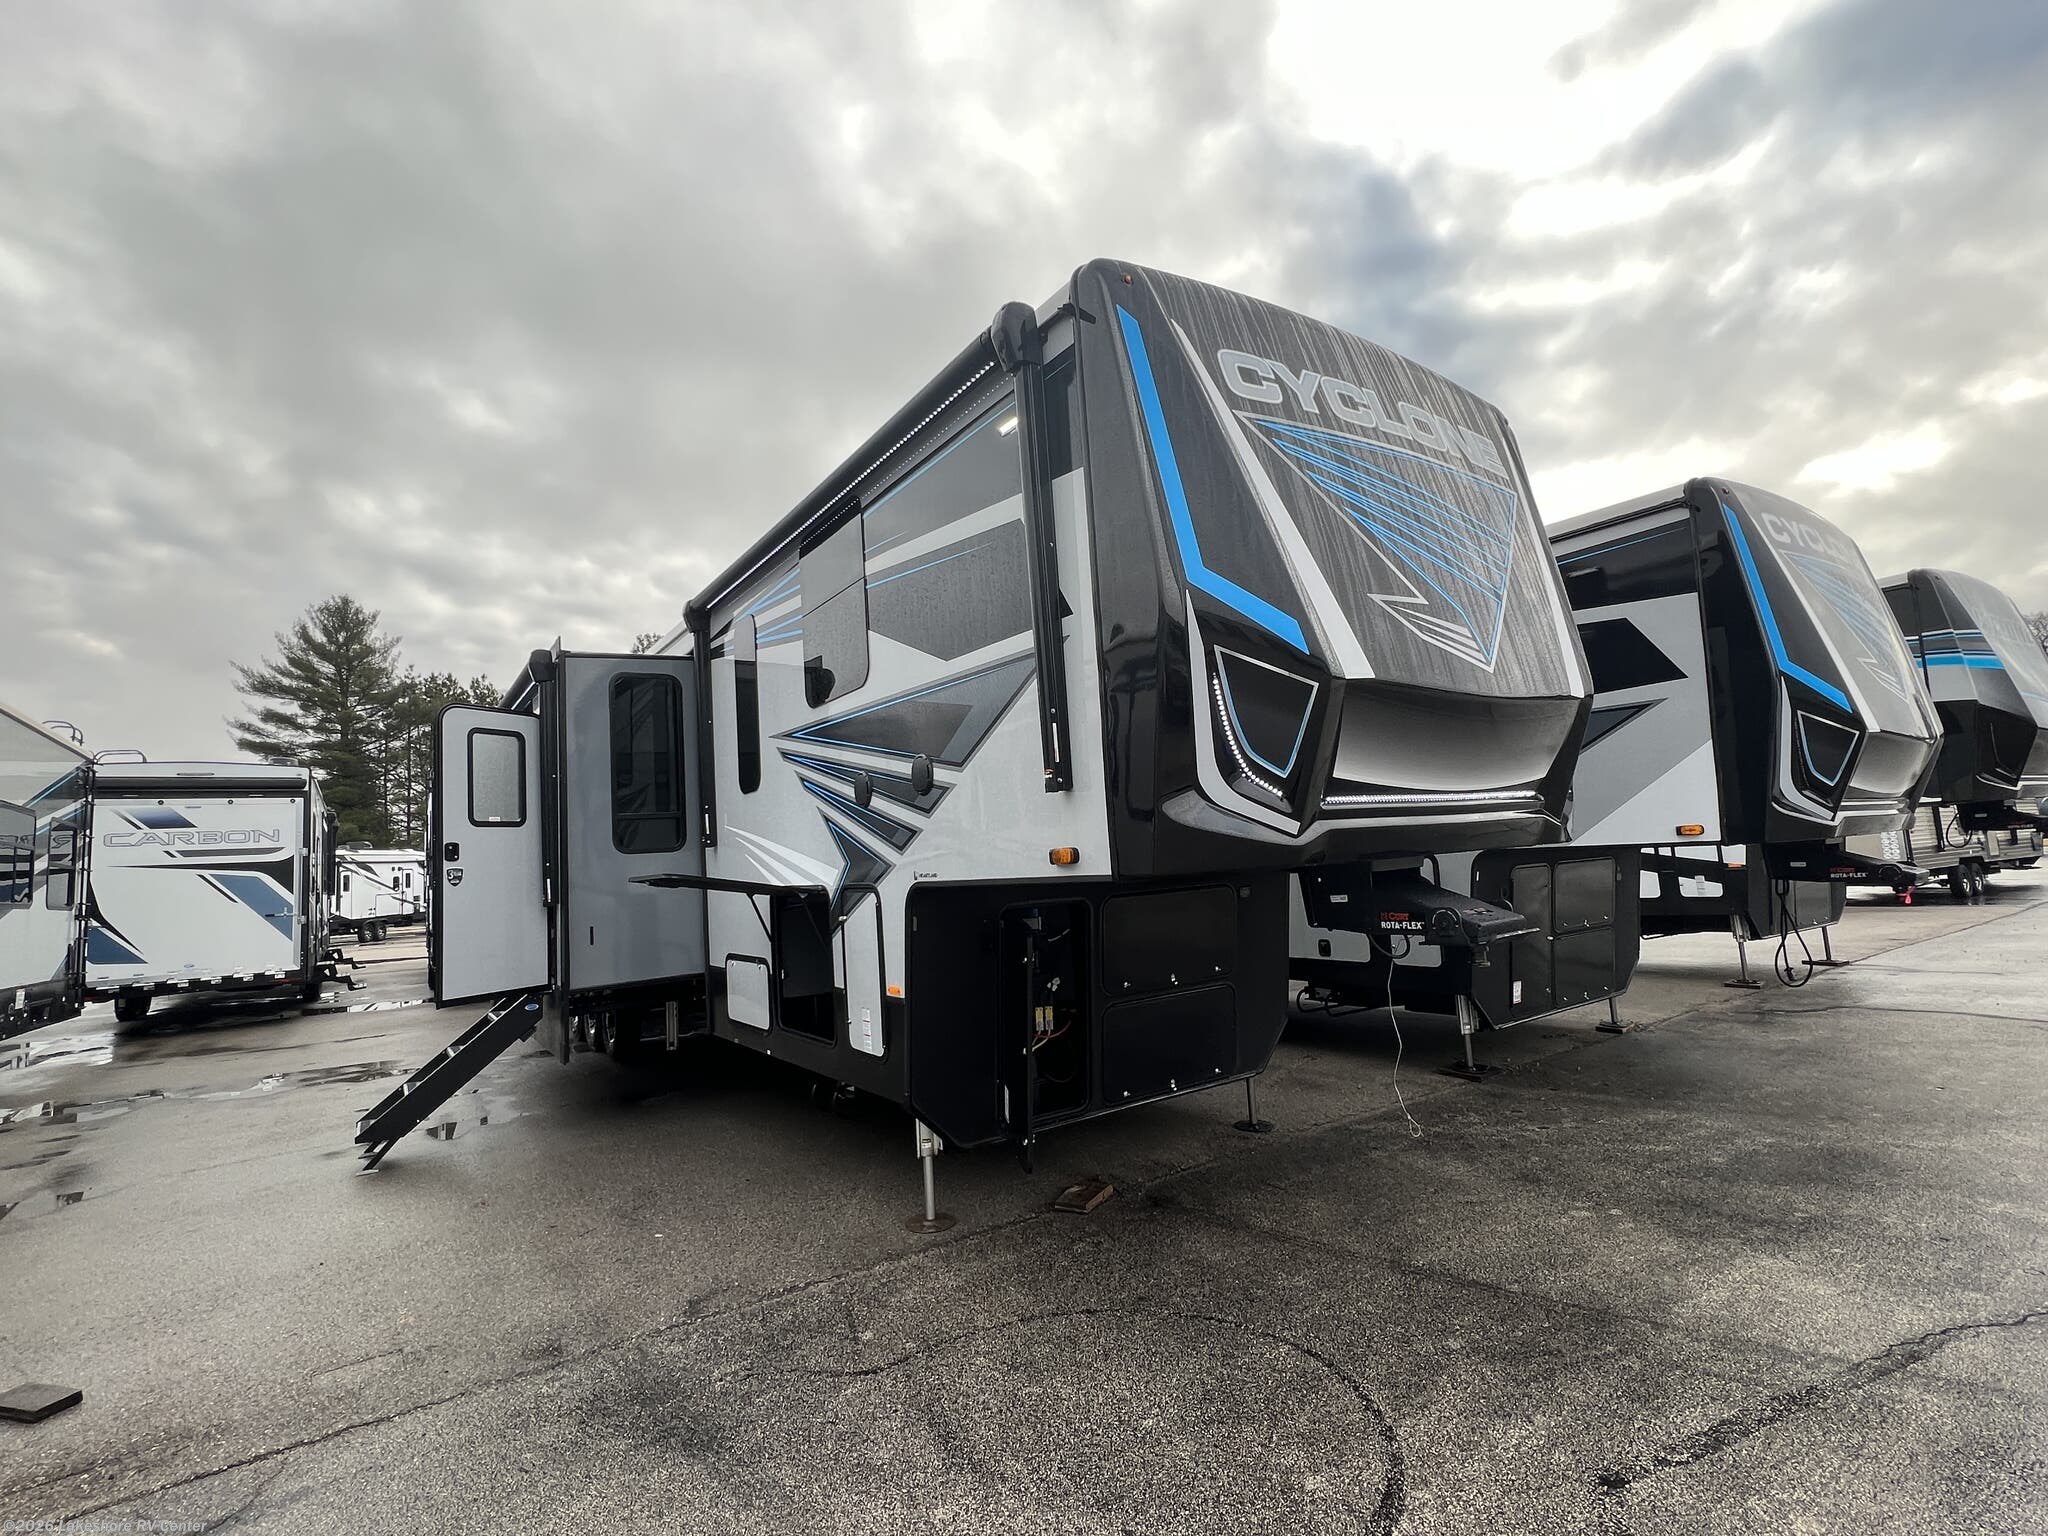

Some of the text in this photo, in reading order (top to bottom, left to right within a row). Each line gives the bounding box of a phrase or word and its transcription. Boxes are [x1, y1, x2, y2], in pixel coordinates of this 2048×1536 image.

[1217, 349, 1510, 481] CYCLONE
[1761, 512, 1856, 568] CYCL
[103, 829, 280, 848] CARBON
